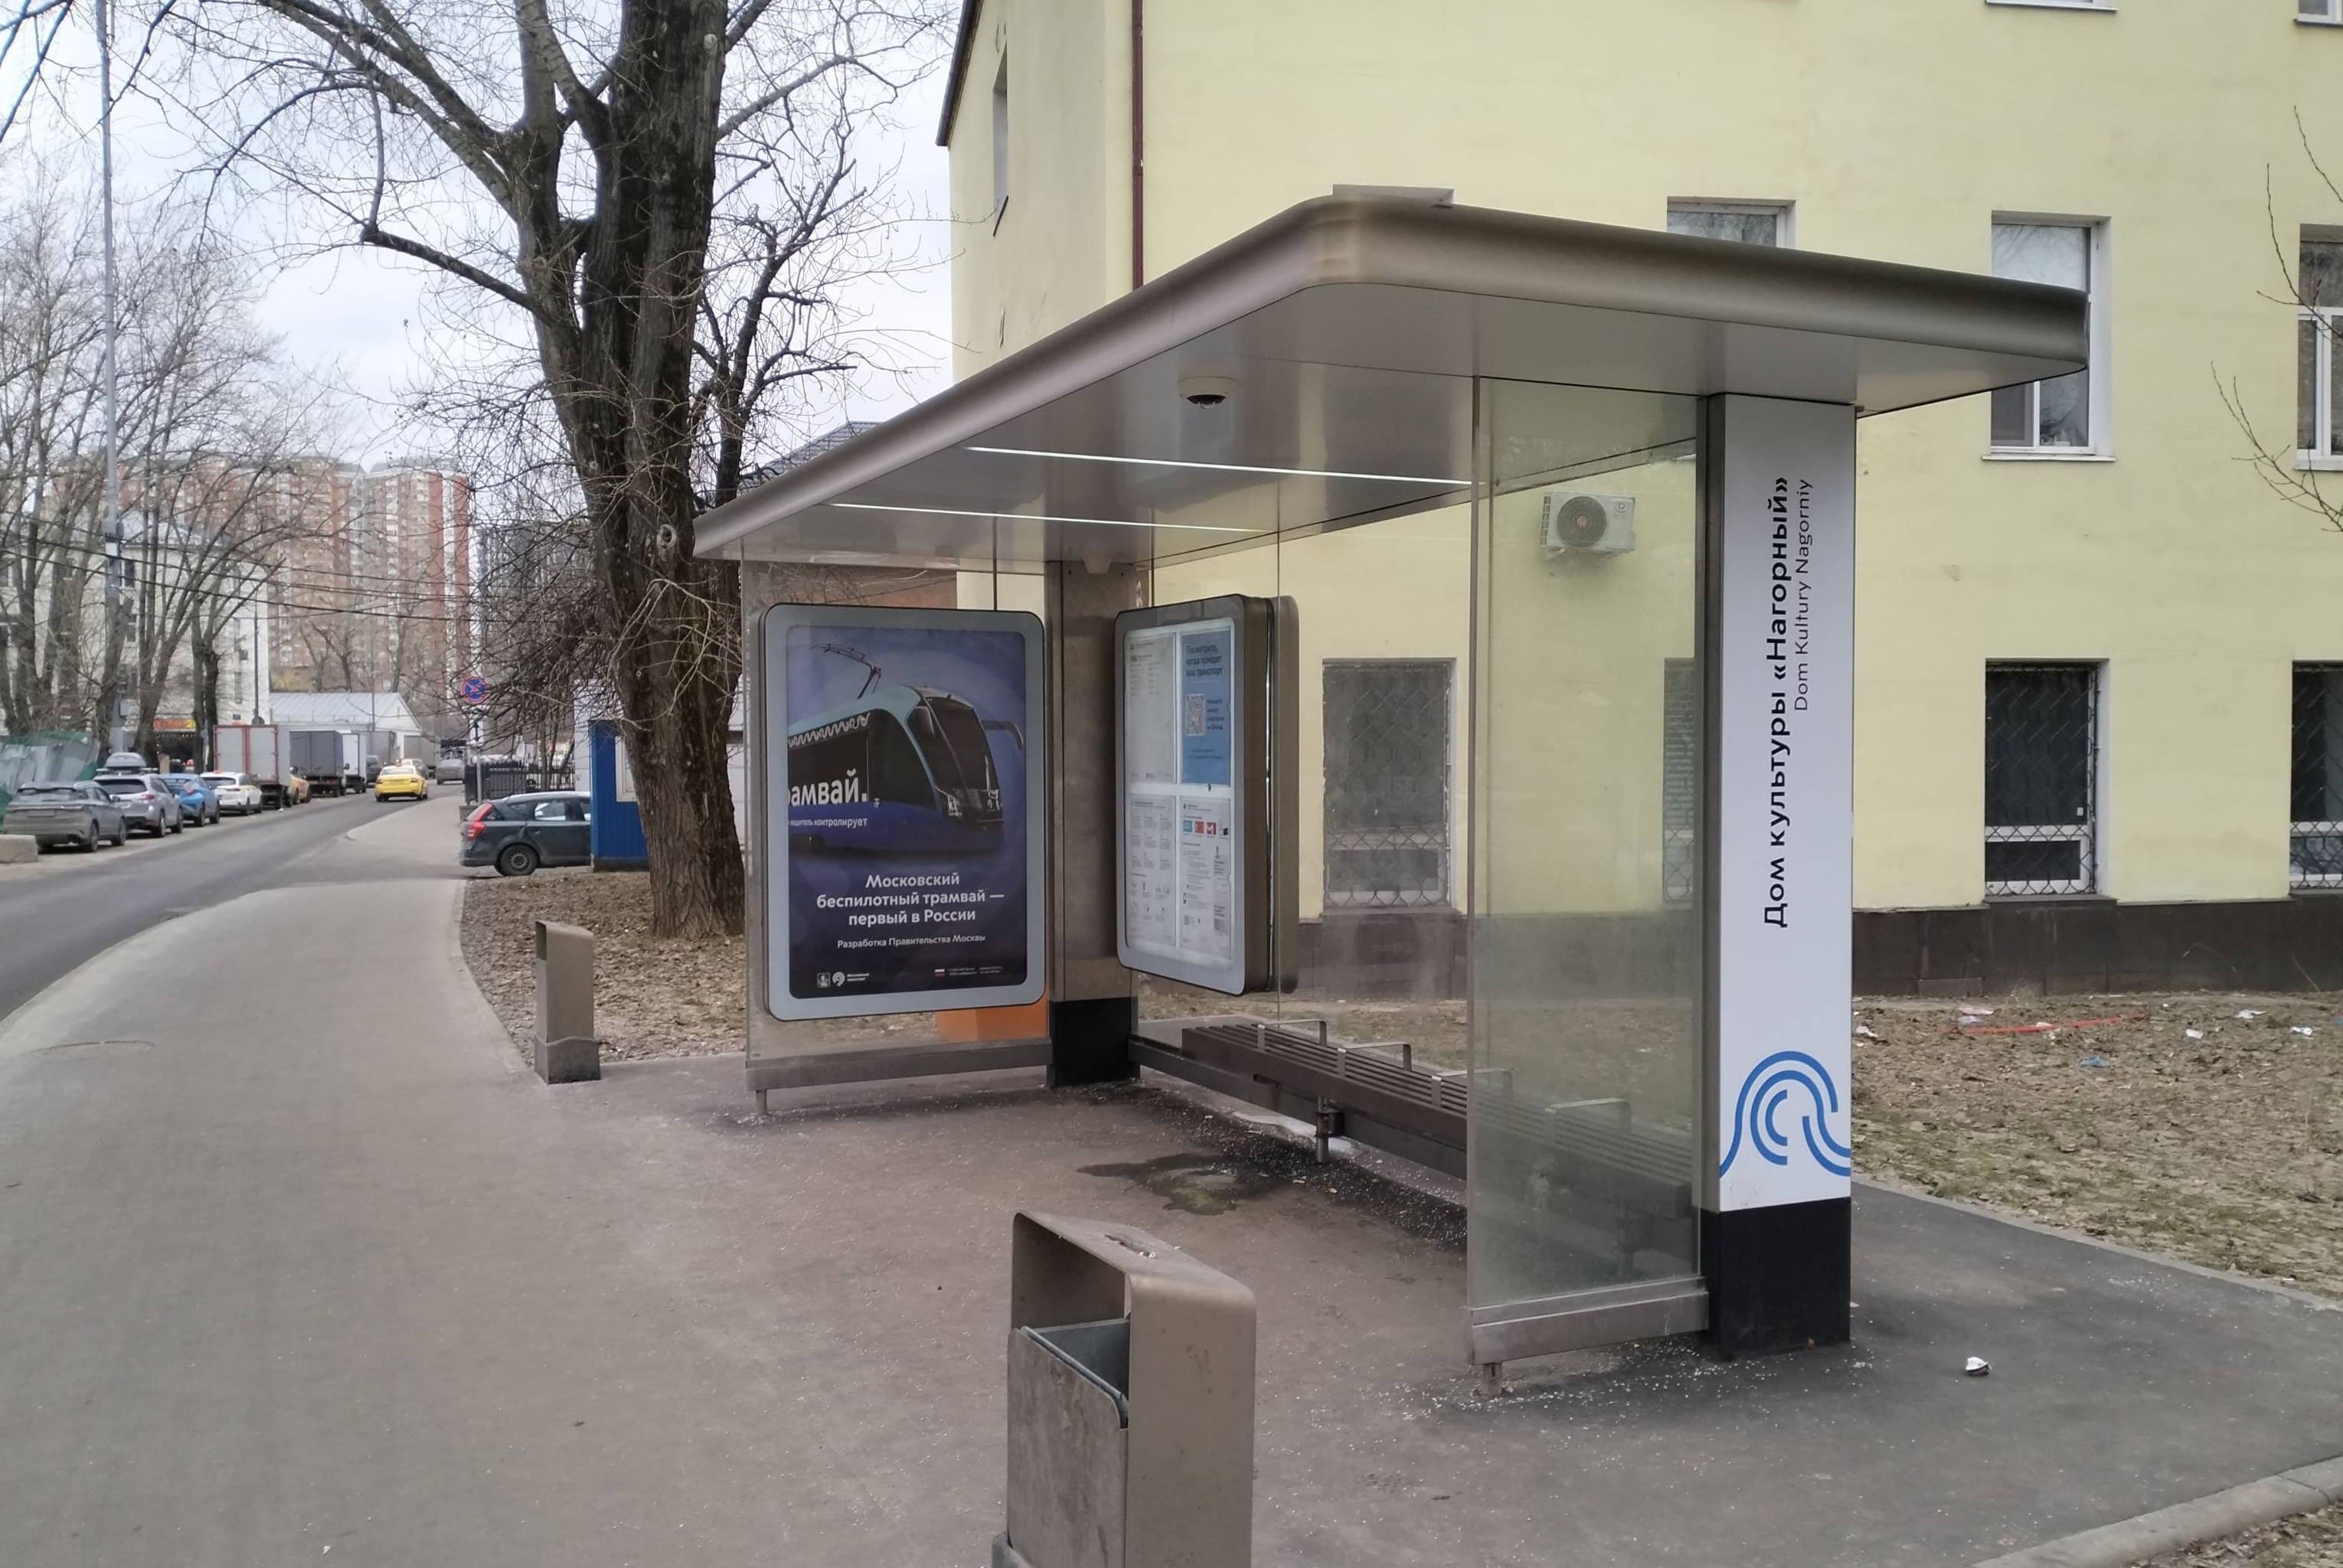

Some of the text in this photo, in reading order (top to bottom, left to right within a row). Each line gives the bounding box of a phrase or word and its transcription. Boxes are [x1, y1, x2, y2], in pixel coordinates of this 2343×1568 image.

[1794, 479, 1813, 710] Dom Kultury Nagorniy
[1764, 477, 1792, 928] Дом культуры «Нагорный»
[789, 767, 868, 807] амвай.
[814, 818, 868, 828] контролирует
[865, 872, 960, 889] Московский
[816, 892, 920, 909] беспилотный
[923, 890, 986, 906] трамвай
[848, 909, 976, 928] первый в России
[838, 934, 986, 949] Разработка Правительства Москвы
